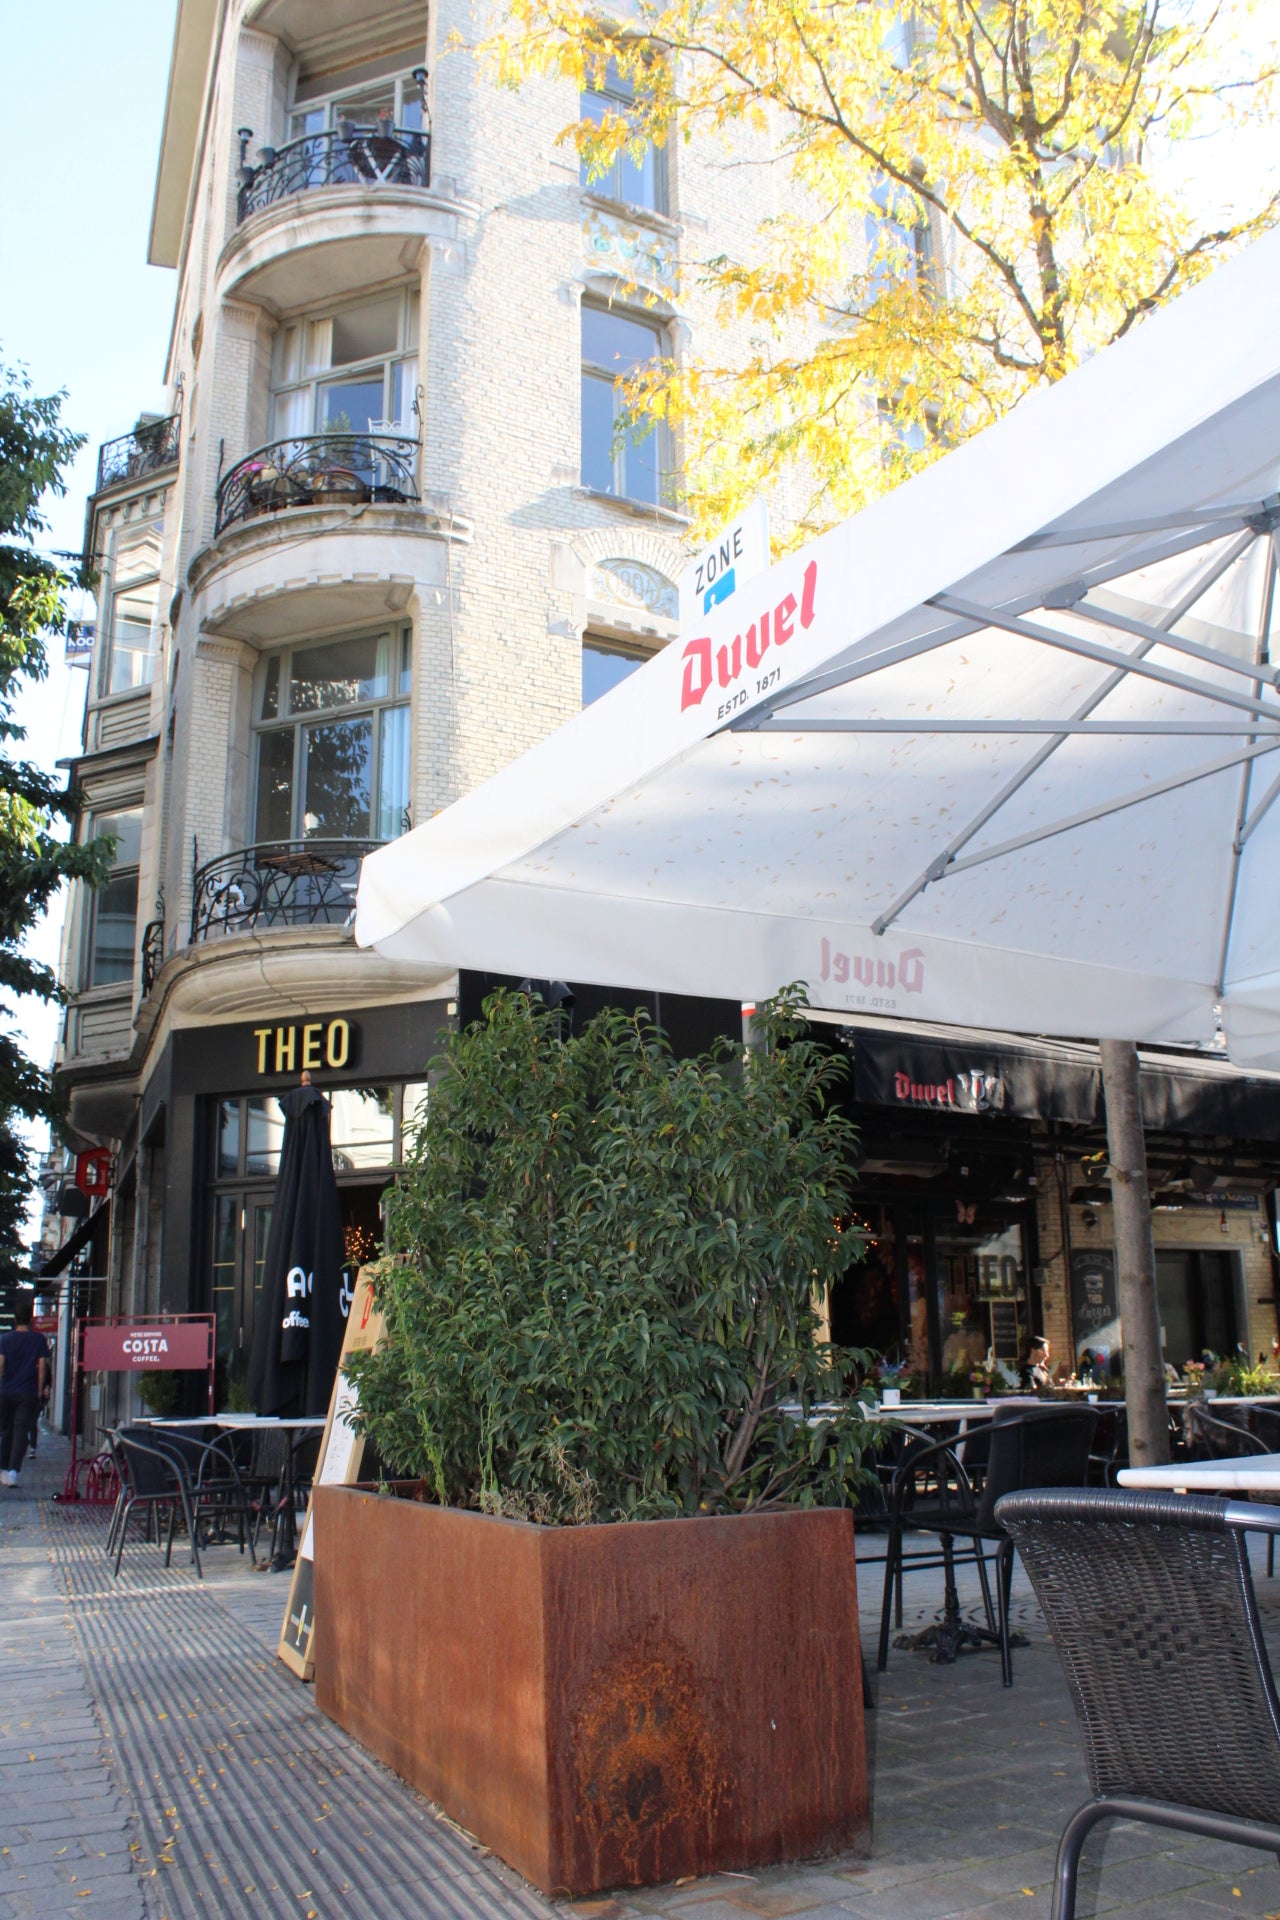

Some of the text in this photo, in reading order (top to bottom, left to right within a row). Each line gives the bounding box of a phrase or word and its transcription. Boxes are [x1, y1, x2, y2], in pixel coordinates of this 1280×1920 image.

[695, 526, 744, 596] ZONE
[680, 559, 818, 714] Duvel
[717, 666, 781, 721] ESTD. 1871
[254, 1018, 349, 1074] THEO
[894, 1071, 955, 1104] Duvel
[943, 1254, 1017, 1297] THEO
[122, 1338, 168, 1354] COSTA
